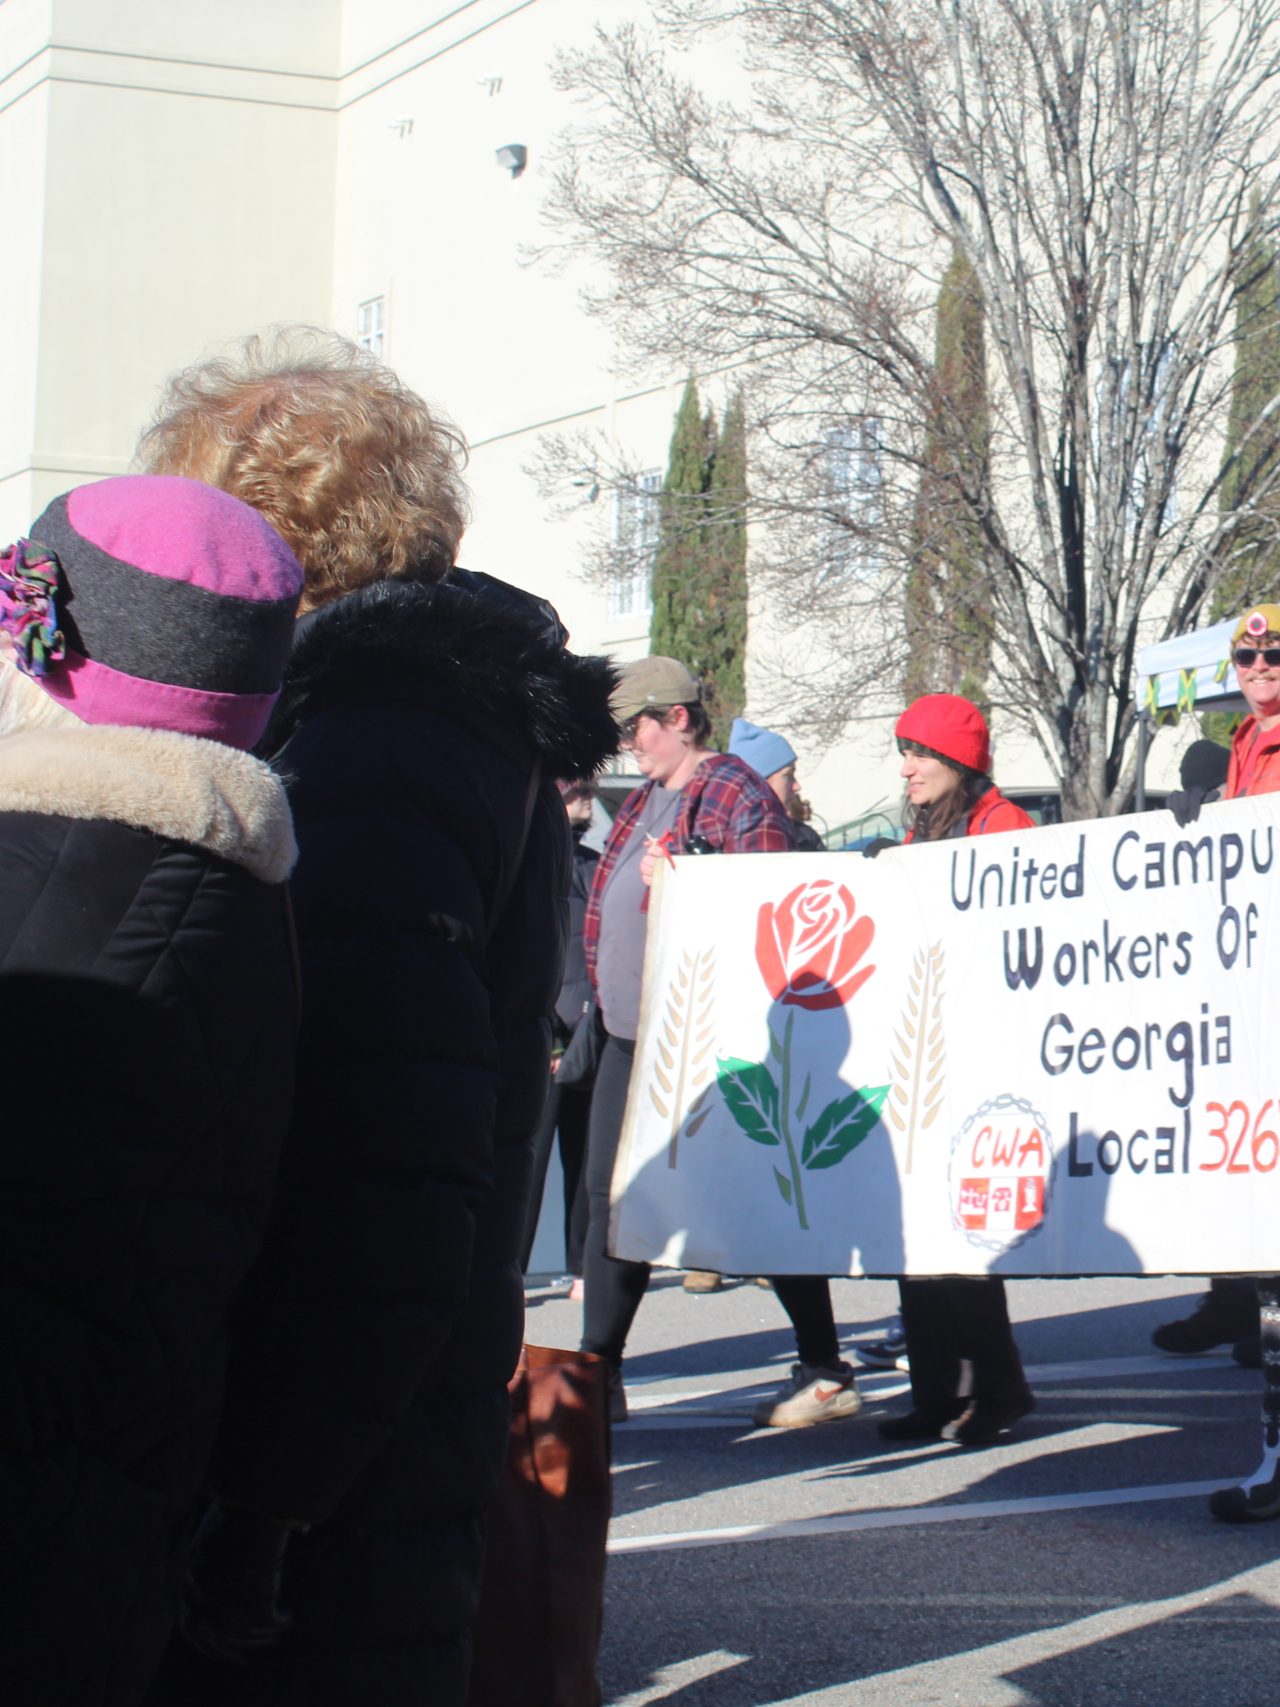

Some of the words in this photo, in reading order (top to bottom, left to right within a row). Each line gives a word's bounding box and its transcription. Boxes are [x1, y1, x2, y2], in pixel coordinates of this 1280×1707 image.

[950, 834, 1088, 911] United
[1002, 919, 1193, 991] Workers
[1216, 902, 1260, 971] Of
[1040, 1003, 1232, 1108] Georgia
[972, 1126, 1044, 1169] CWA
[1068, 1108, 1191, 1178] Local
